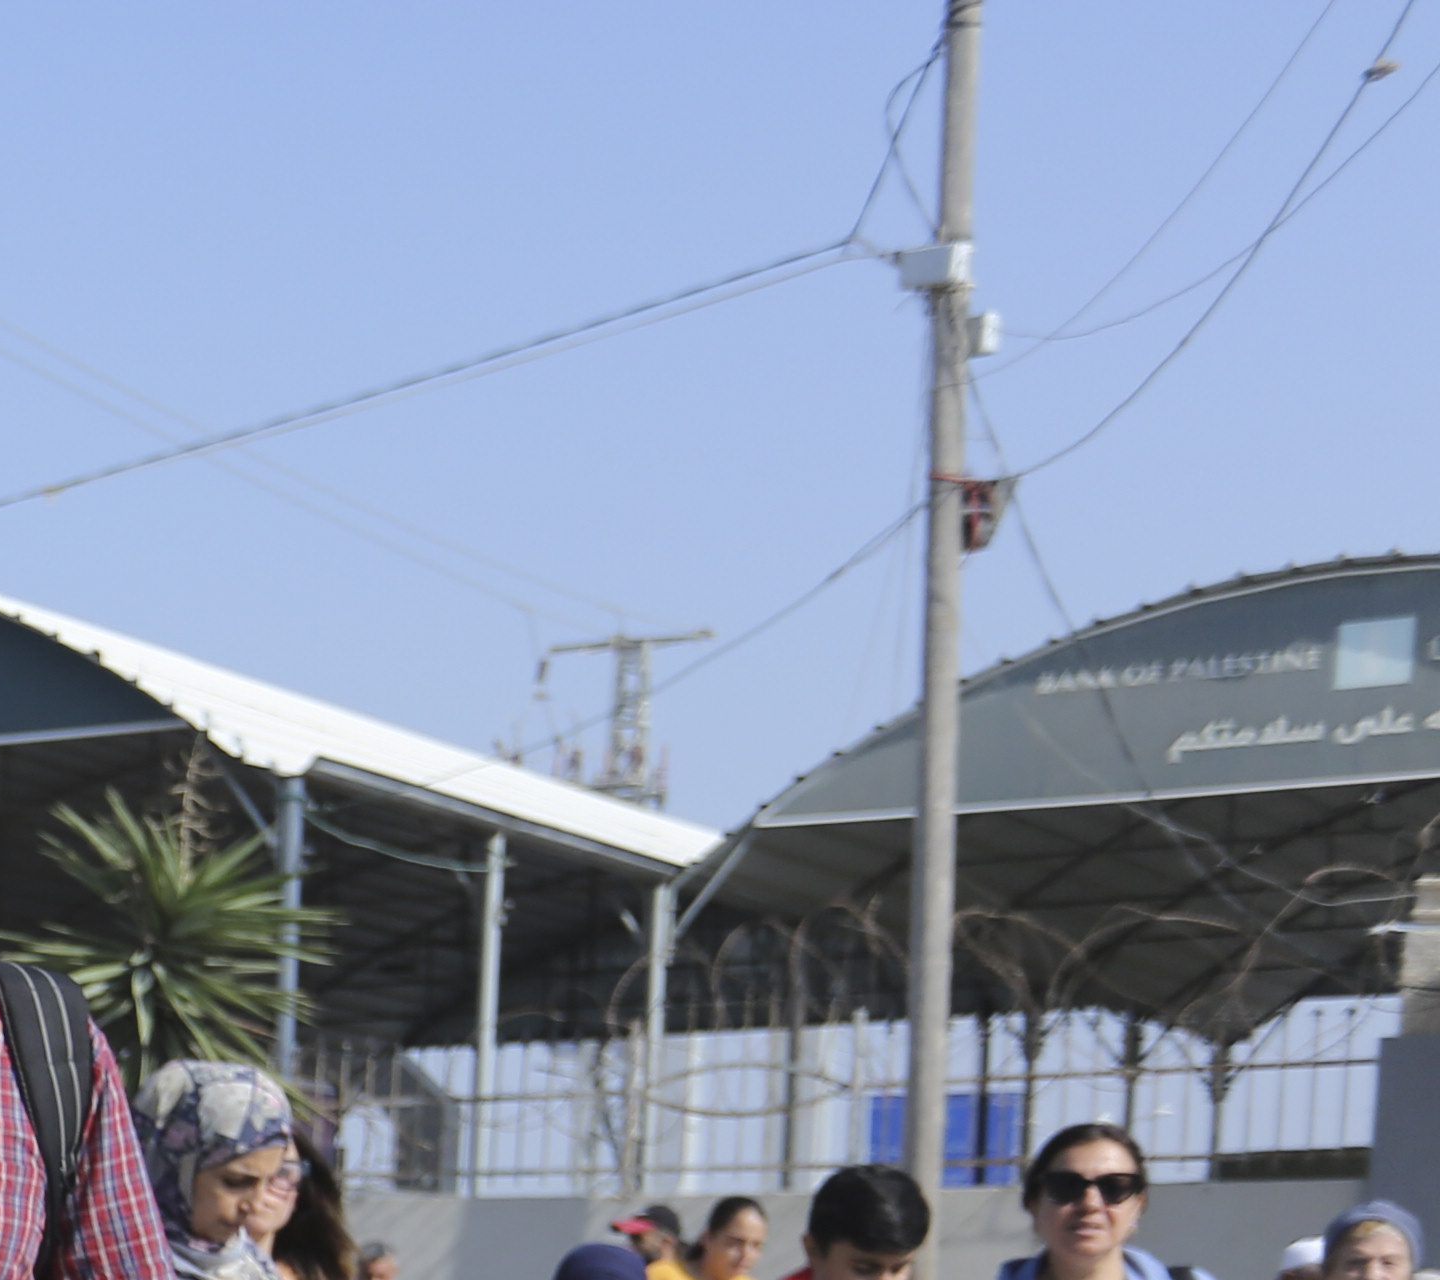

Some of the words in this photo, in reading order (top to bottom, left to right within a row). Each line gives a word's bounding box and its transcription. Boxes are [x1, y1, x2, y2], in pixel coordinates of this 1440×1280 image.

[1036, 667, 1118, 695] BANK
[1120, 660, 1165, 687] OF
[1168, 644, 1322, 682] PALESTINE
[1166, 714, 1327, 764] سلامتكم
[1331, 707, 1415, 745] على
